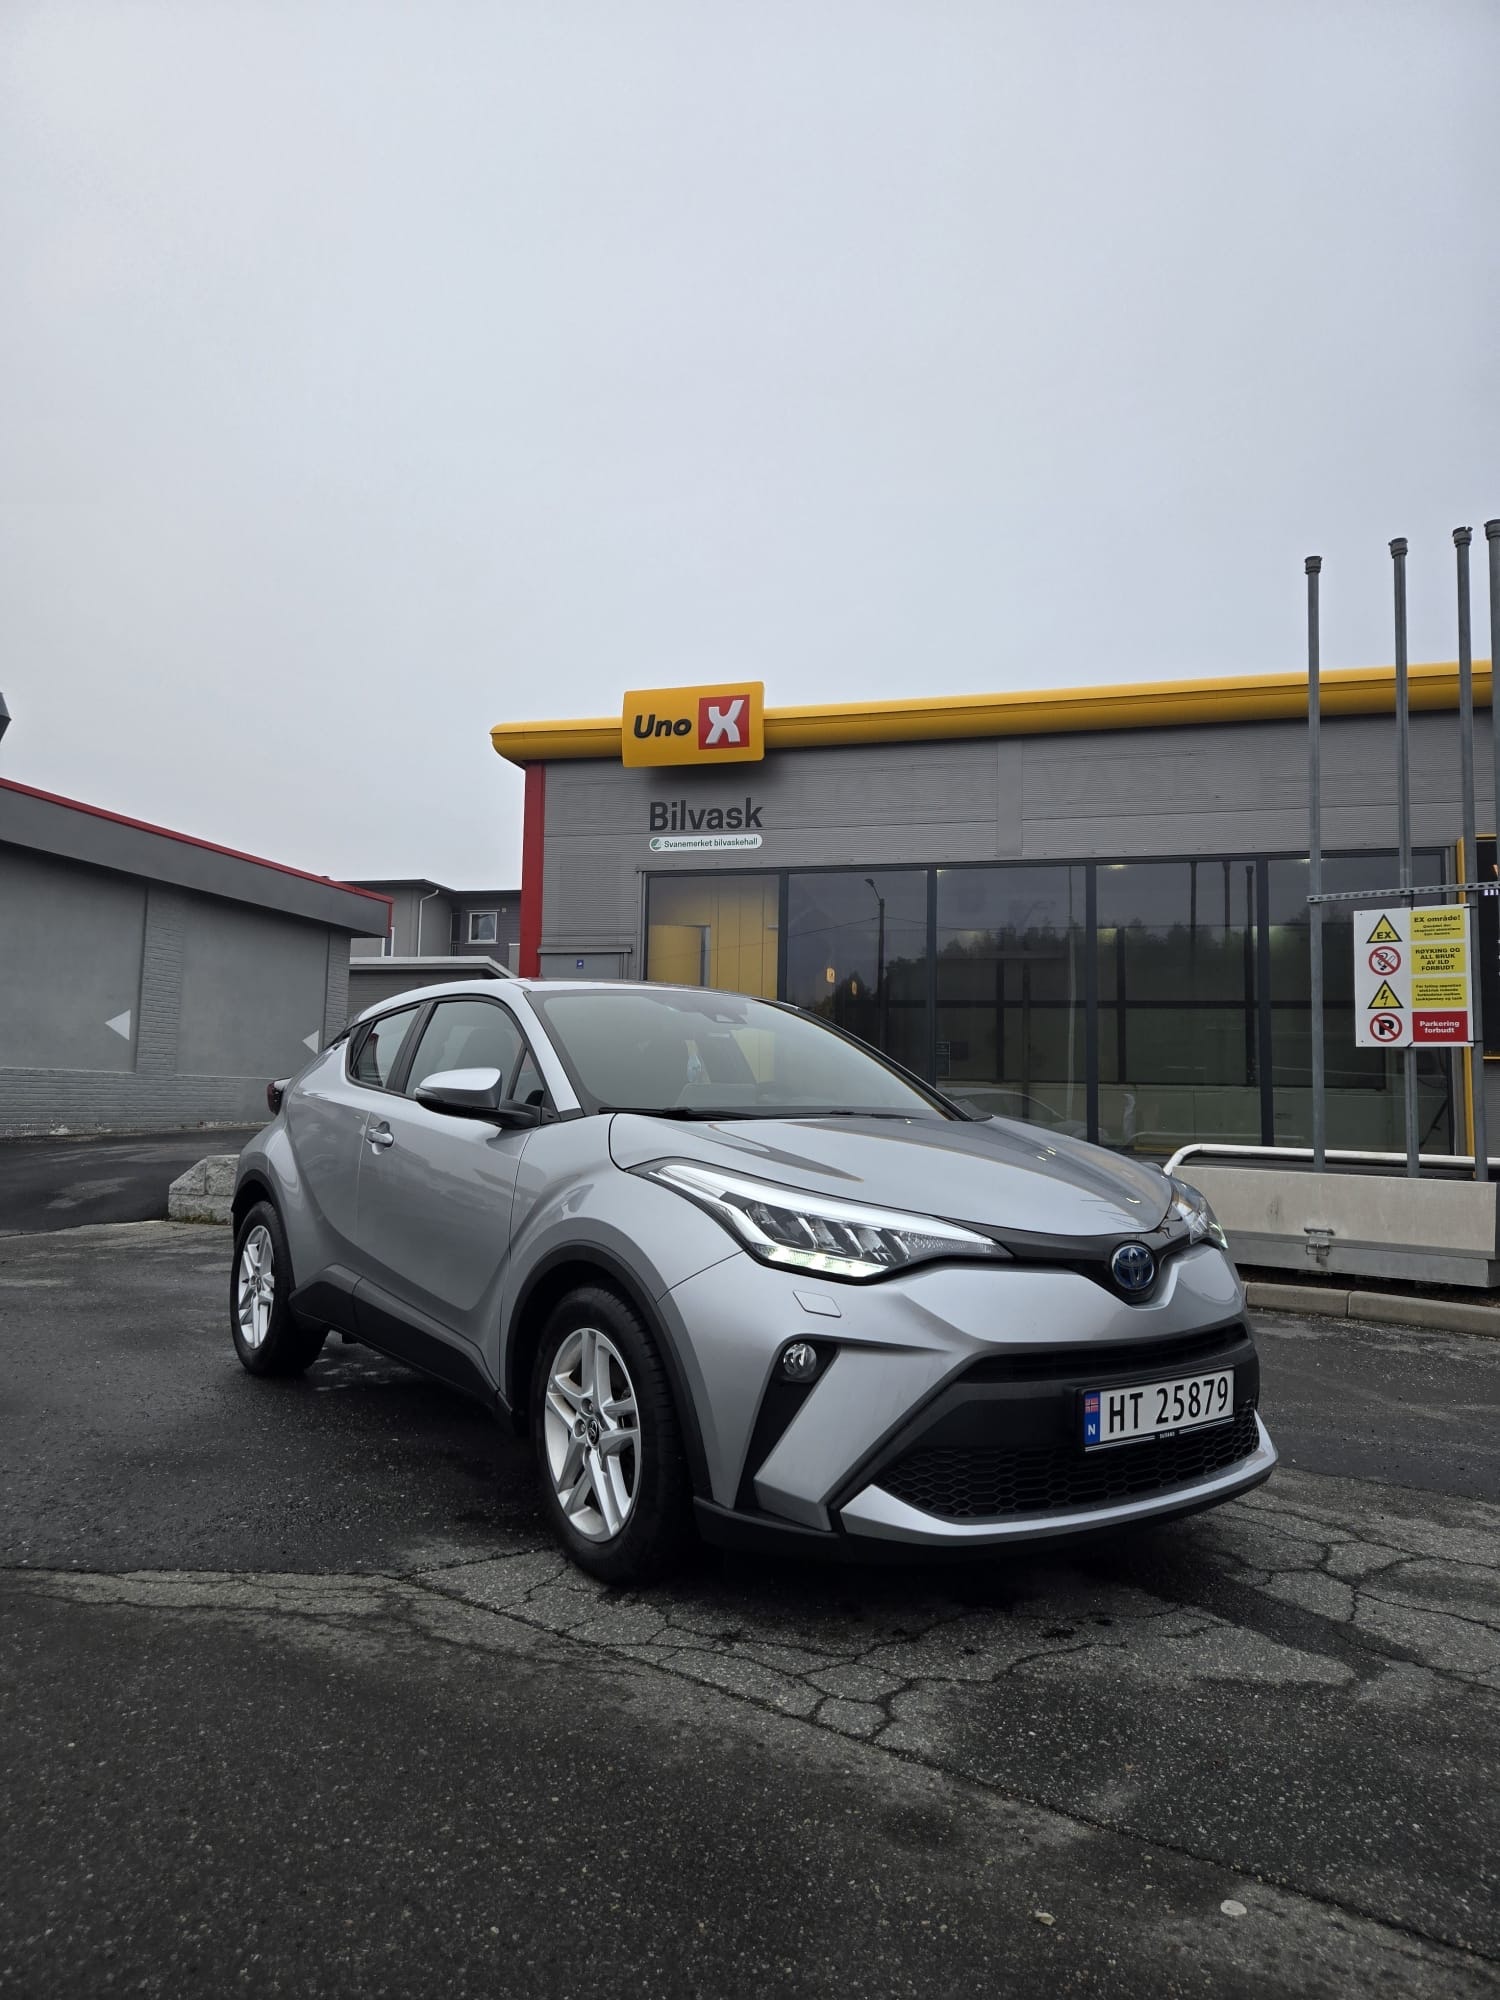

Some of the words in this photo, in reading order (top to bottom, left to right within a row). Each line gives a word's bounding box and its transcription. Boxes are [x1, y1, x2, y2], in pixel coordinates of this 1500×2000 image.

[633, 714, 692, 739] Uno
[705, 699, 745, 745] X
[650, 797, 763, 832] Bilvask
[664, 840, 713, 849] Svanemerket
[714, 837, 758, 847] bilvaskehall
[1427, 914, 1461, 923] område!
[1376, 931, 1392, 940] EX
[1420, 1020, 1460, 1028] Parkering
[1109, 1391, 1144, 1434] HT
[1155, 1376, 1229, 1425] 25879
[1087, 1423, 1096, 1436] N
